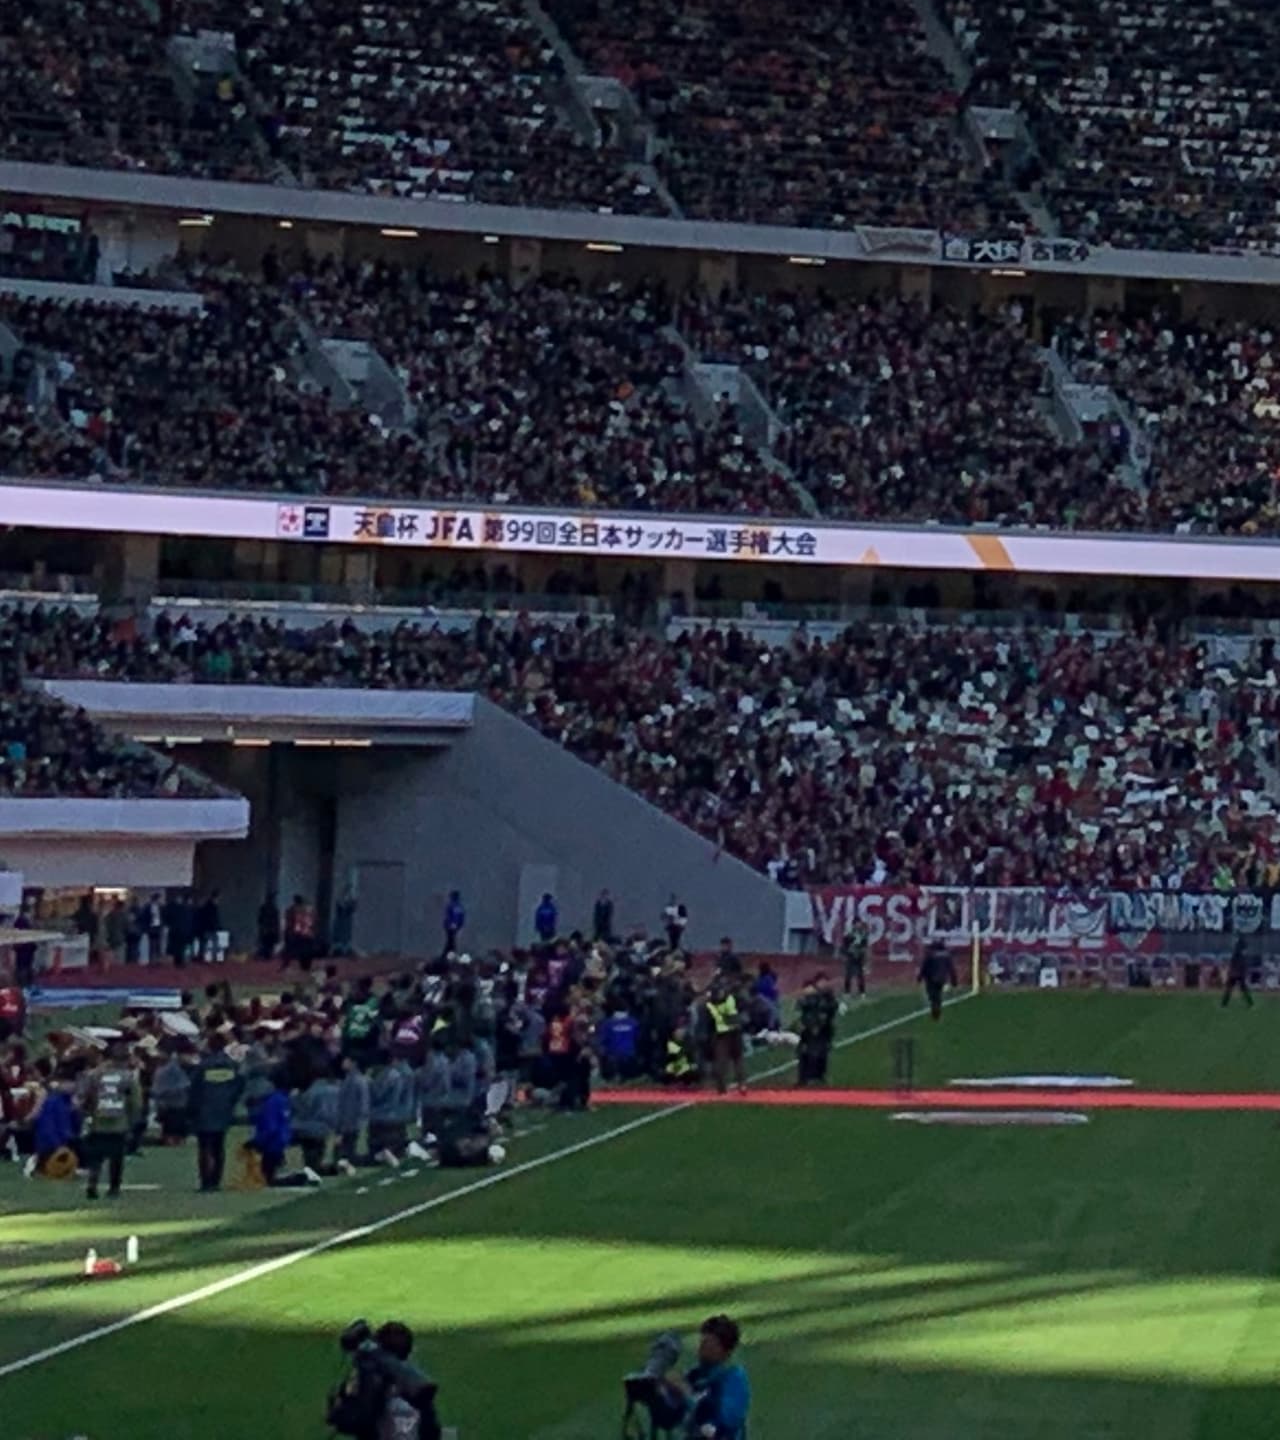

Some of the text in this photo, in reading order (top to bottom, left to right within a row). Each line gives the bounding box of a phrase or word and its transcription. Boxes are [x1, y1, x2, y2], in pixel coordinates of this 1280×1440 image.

[353, 510, 419, 538] 天皇杯
[425, 515, 474, 542] JFA
